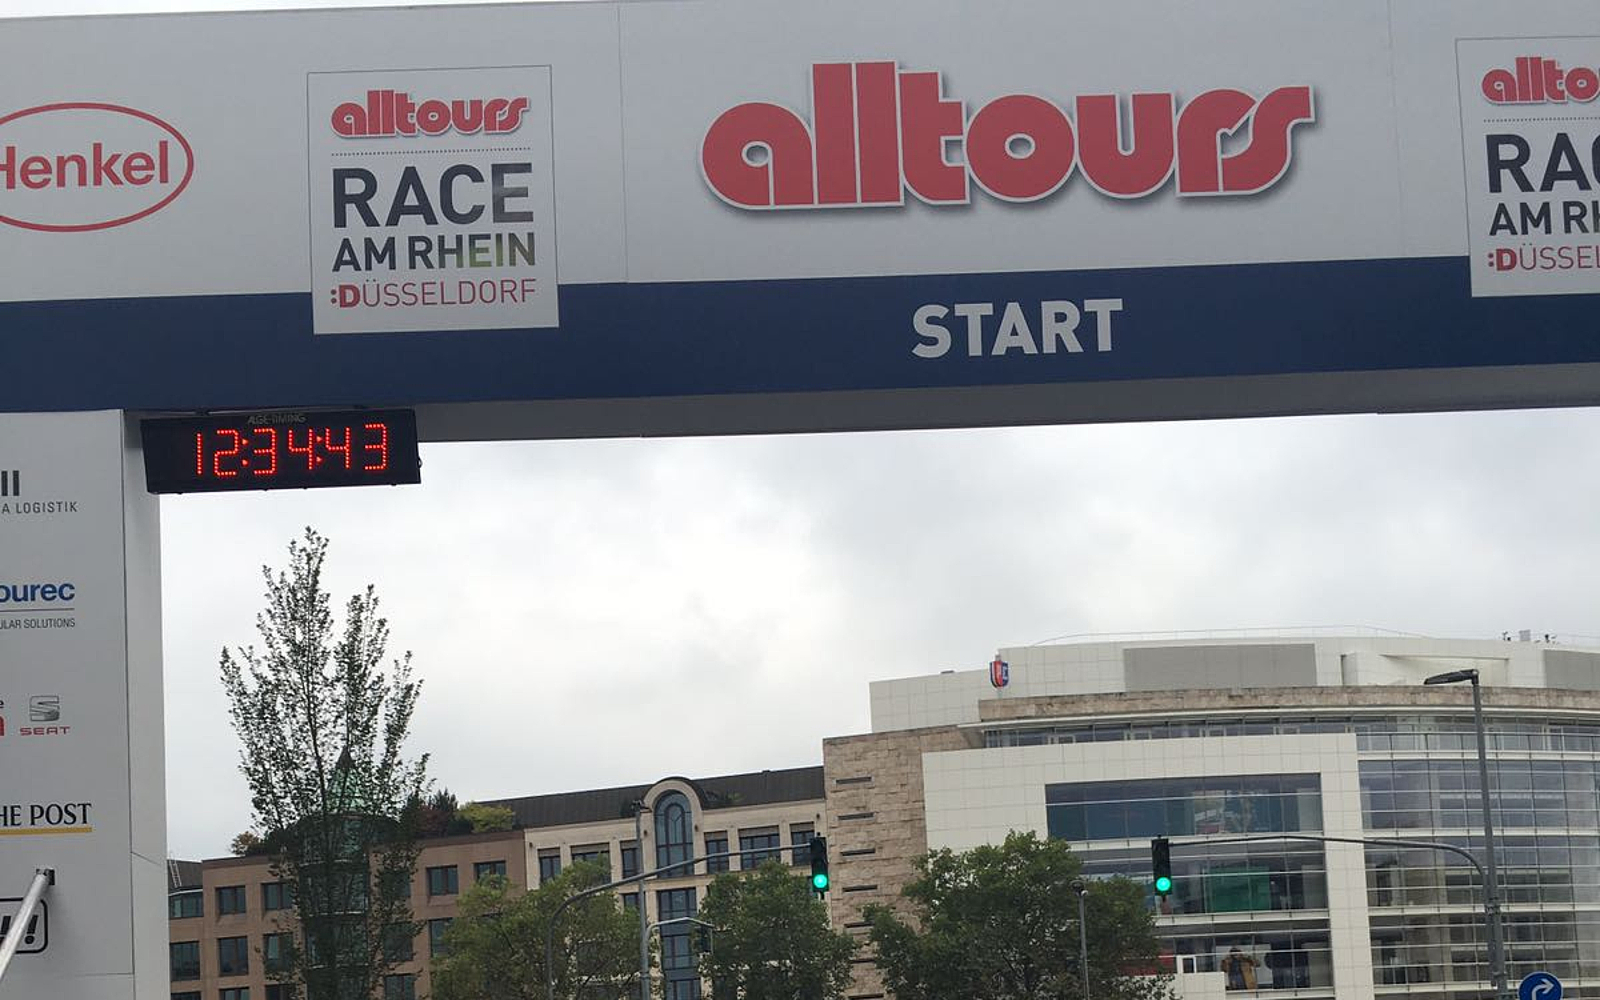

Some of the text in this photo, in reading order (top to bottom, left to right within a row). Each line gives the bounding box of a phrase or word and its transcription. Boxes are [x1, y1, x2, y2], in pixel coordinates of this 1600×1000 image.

[1481, 56, 1600, 103] allto
[331, 89, 530, 138] alltours
[700, 61, 1316, 210] alltours
[1486, 132, 1600, 193] RA
[332, 162, 534, 228] RACE
[1489, 201, 1552, 236] AM
[332, 232, 536, 272] AM RHEIN
[330, 278, 537, 308] :DÜSSELDORF
[911, 298, 1123, 358] START
[196, 423, 388, 476] 12:34:43
[15, 500, 79, 515] LOGISTIK
[23, 618, 76, 629] SOLUTIONS
[20, 726, 71, 736] SEAT
[30, 803, 92, 826] POST
